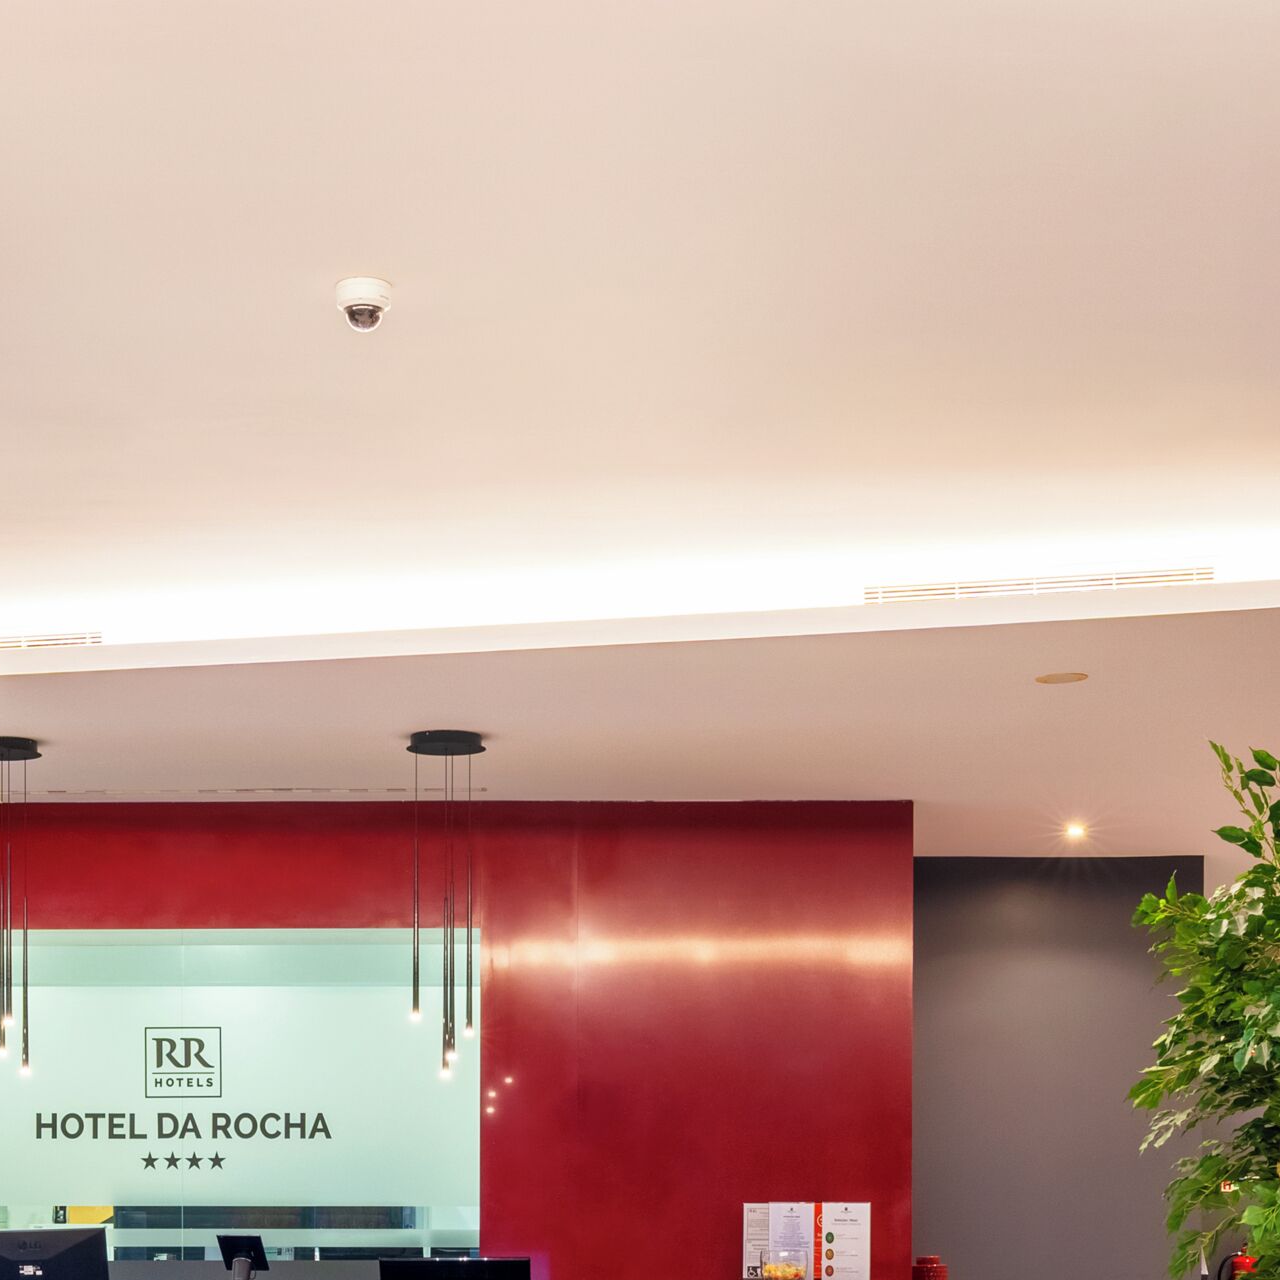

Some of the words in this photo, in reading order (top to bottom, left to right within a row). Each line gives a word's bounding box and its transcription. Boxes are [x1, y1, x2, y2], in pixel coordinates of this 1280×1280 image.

[152, 1038, 215, 1068] RR
[154, 1078, 213, 1087] HOTELS
[35, 1112, 147, 1140] HOTEL
[157, 1112, 202, 1140] DA
[211, 1112, 332, 1140] ROCHA
